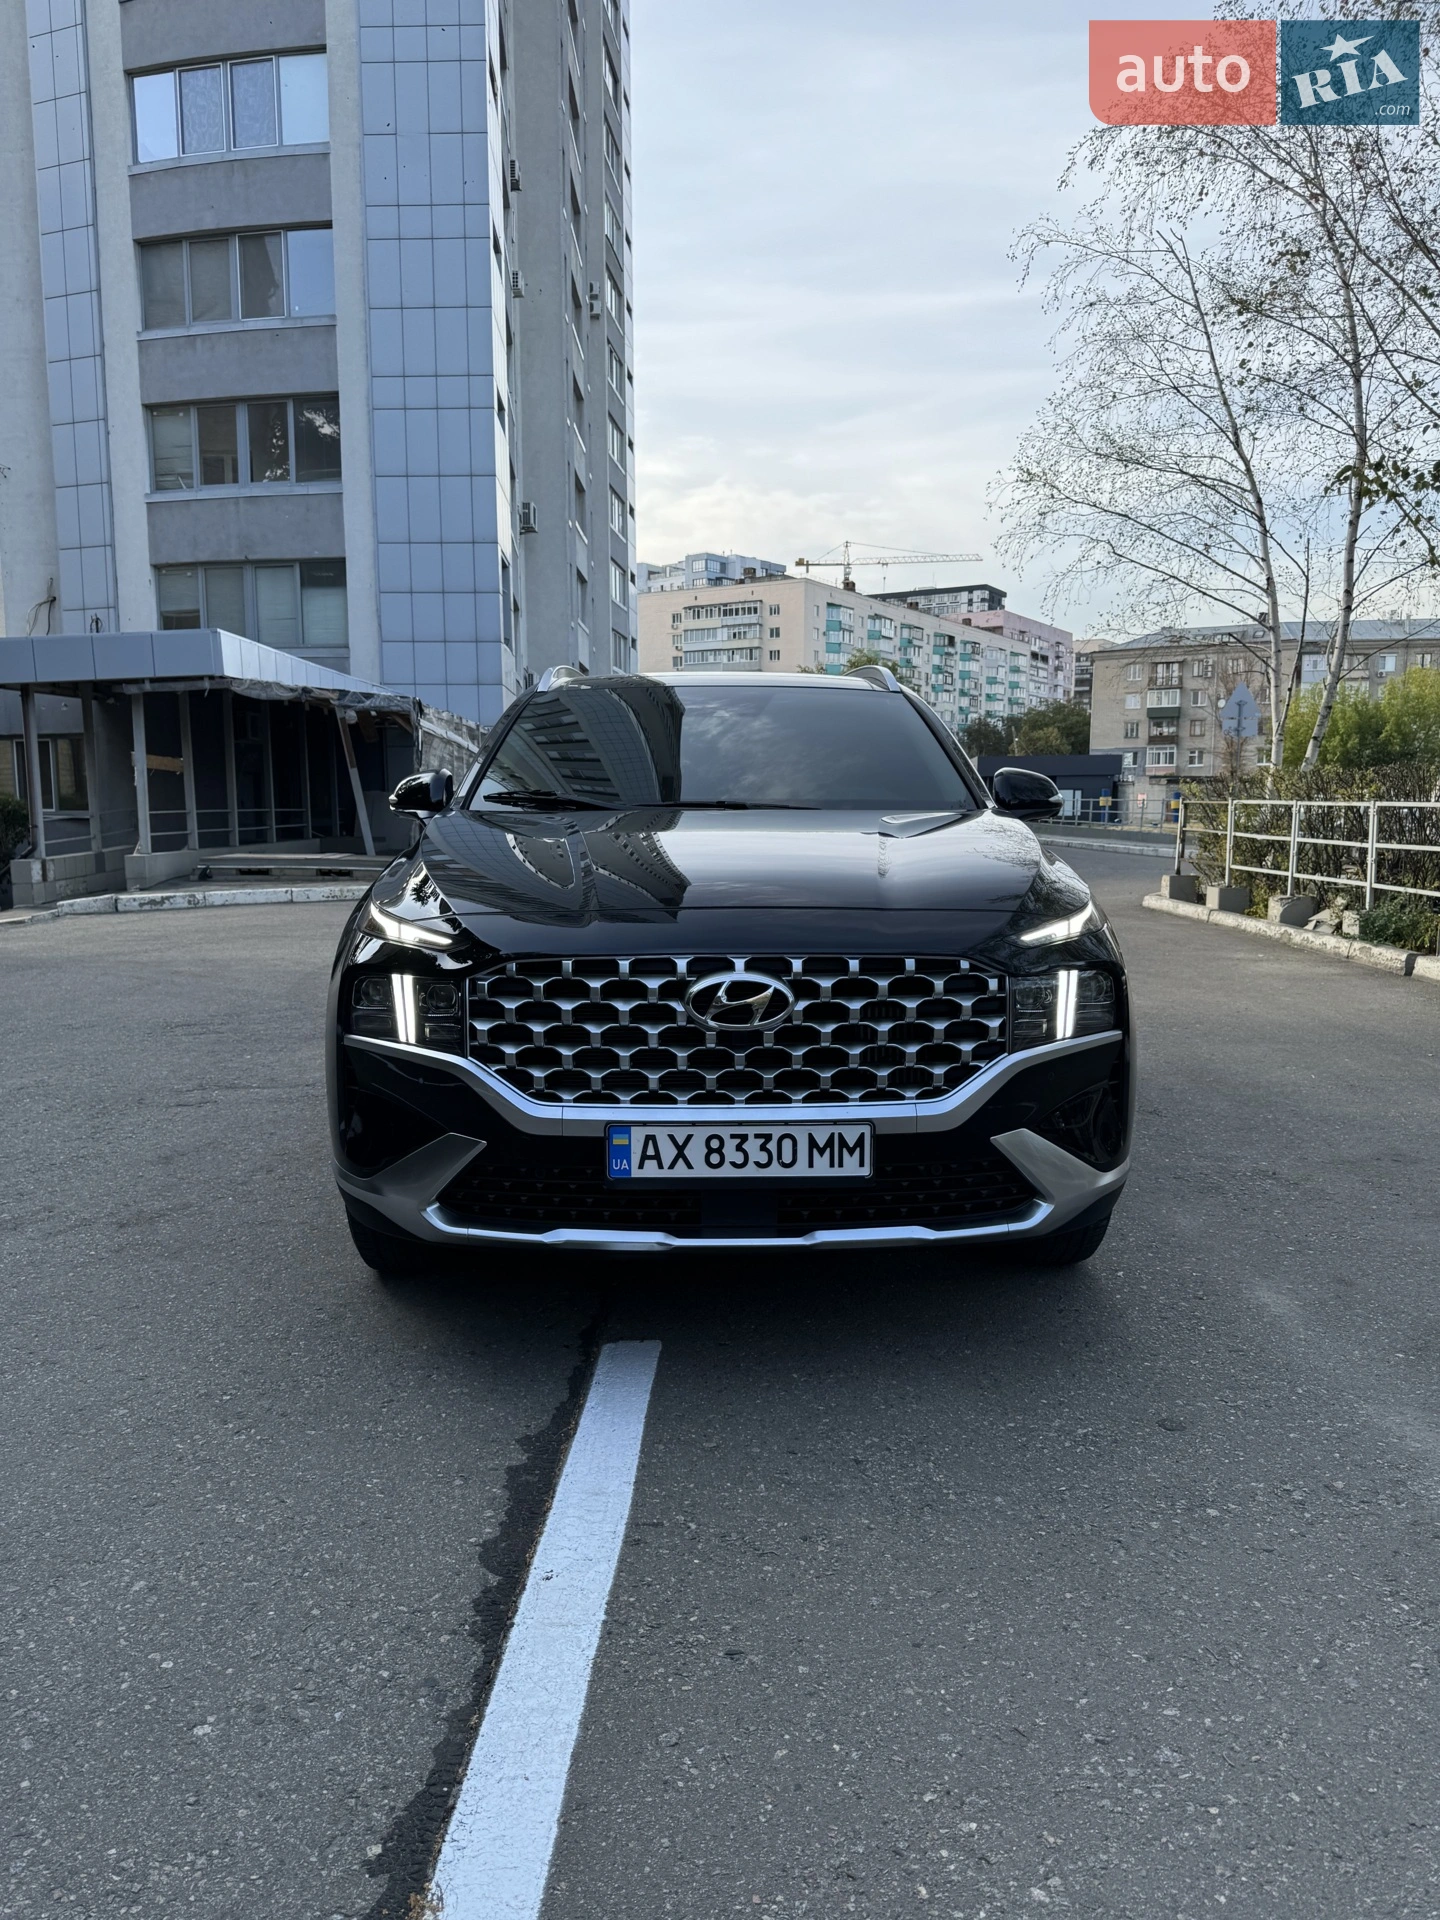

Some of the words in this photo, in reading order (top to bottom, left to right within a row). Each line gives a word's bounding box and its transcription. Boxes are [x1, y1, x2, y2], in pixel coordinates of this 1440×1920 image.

[637, 1134, 694, 1169] AX
[704, 1133, 798, 1169] 8330
[808, 1132, 865, 1168] MM
[612, 1159, 629, 1170] UA
